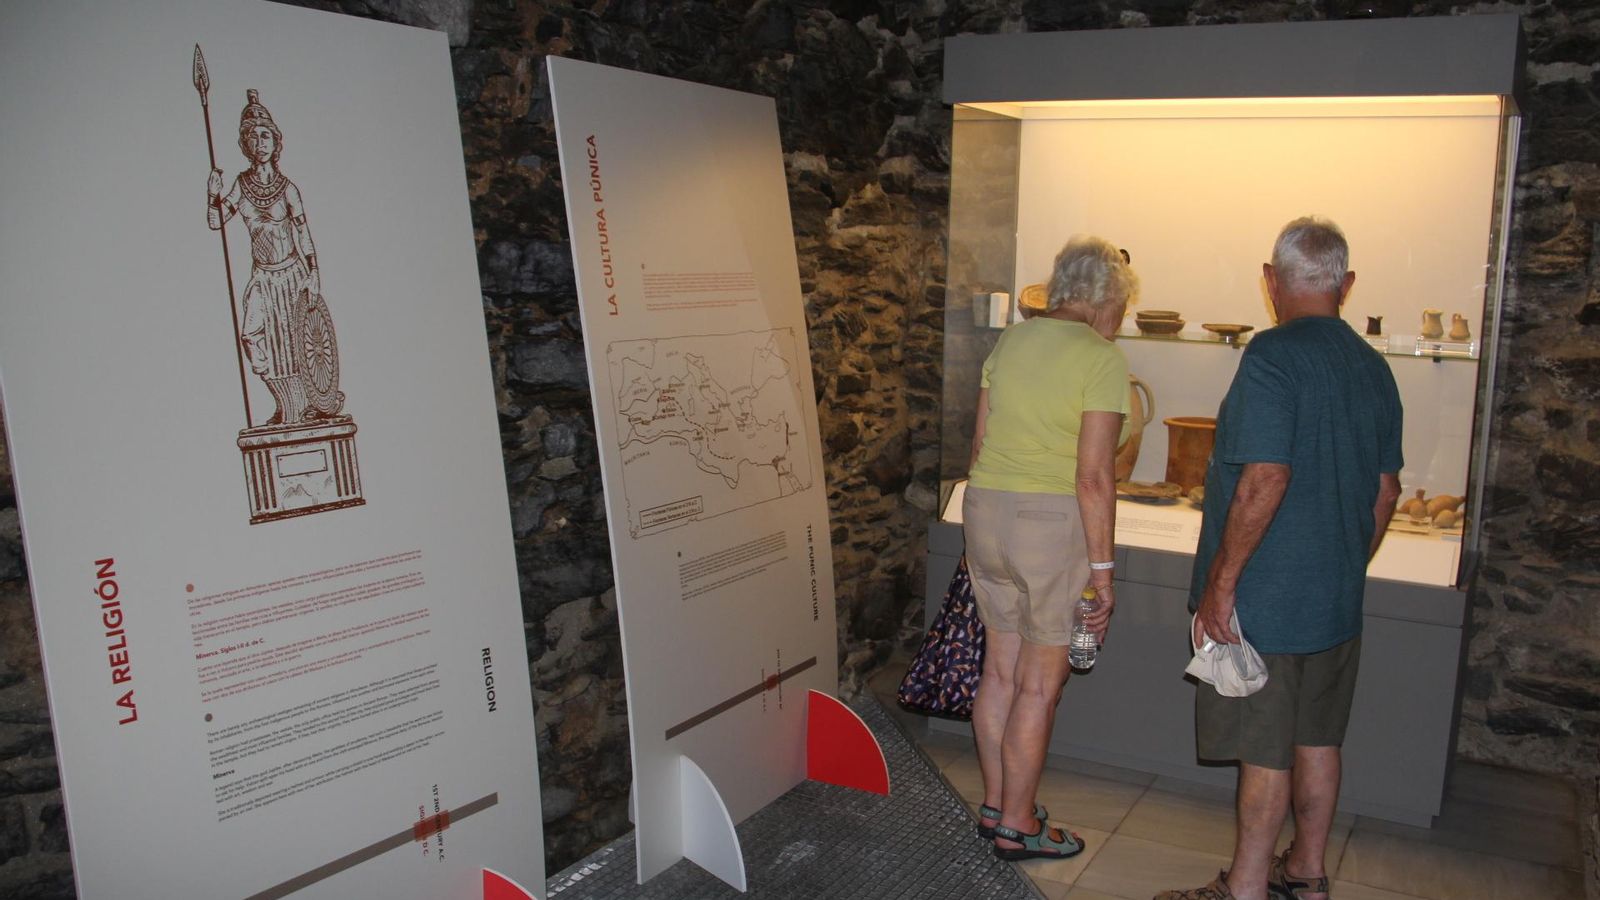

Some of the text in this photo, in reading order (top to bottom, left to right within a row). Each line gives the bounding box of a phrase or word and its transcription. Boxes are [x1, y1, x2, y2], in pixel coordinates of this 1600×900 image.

[586, 134, 619, 316] LA CULTURA PÚNICA
[808, 545, 816, 577] PUNIC
[811, 578, 819, 622] CULTURE
[93, 557, 138, 725] LA RELIGIÓN
[481, 647, 497, 713] RELIGION
